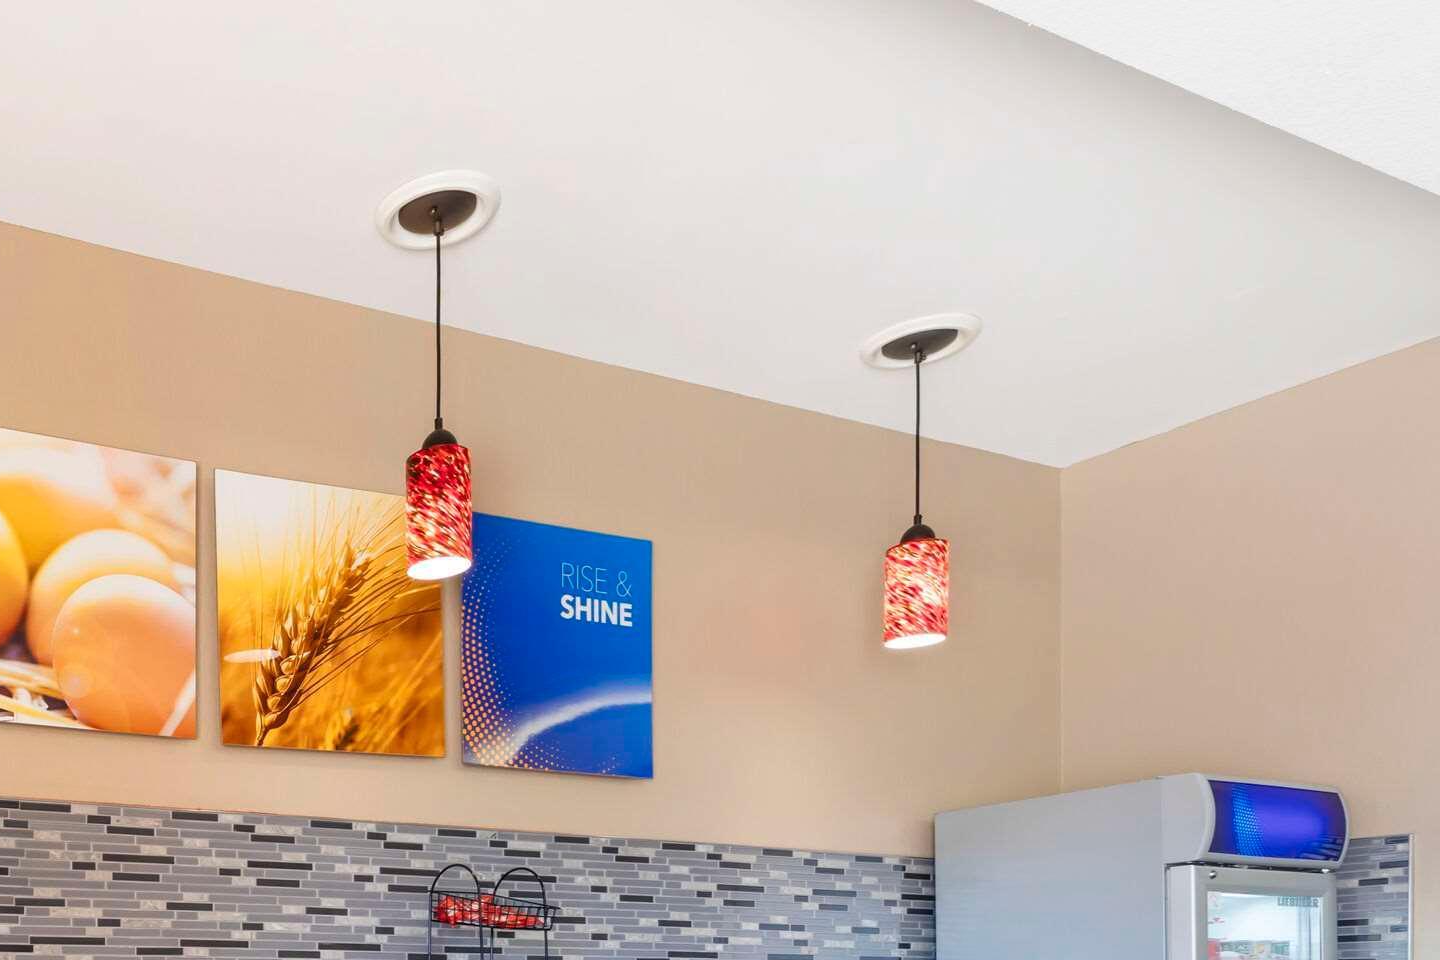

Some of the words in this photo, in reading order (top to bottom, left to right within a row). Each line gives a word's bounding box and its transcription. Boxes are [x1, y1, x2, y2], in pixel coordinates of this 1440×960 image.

[561, 562, 608, 594] RISE
[616, 570, 632, 598] &
[560, 594, 633, 627] SHINE
